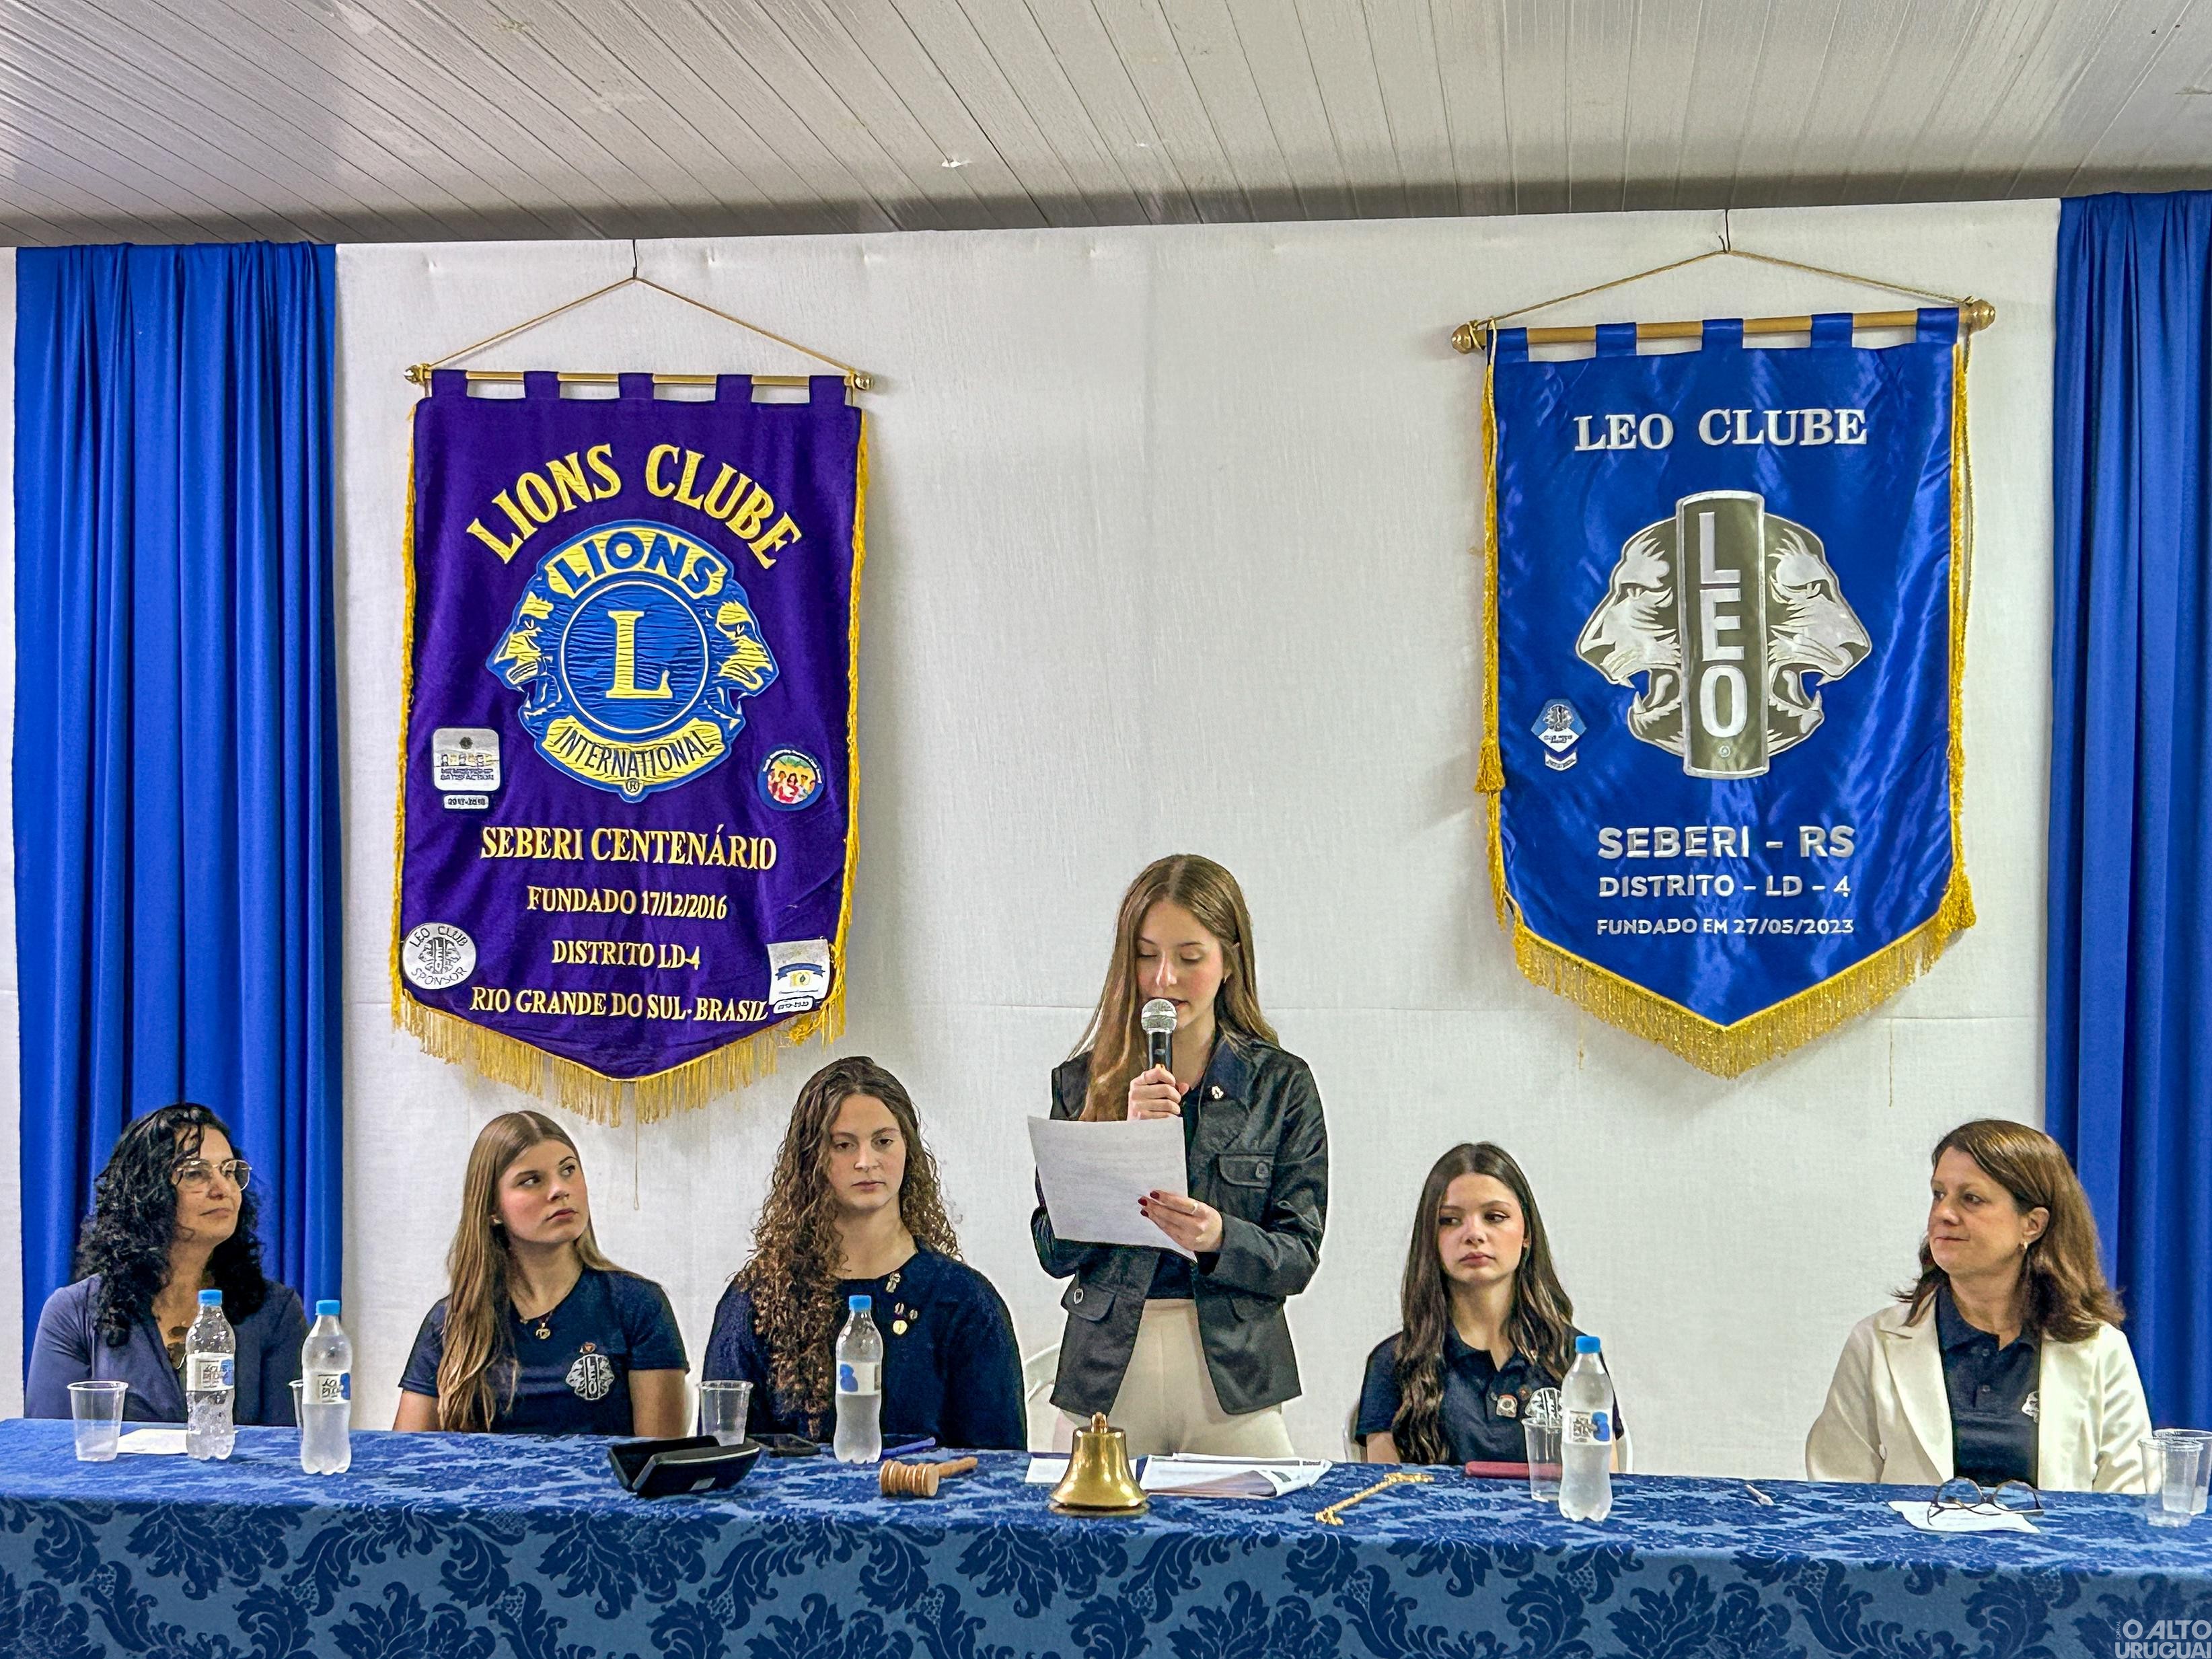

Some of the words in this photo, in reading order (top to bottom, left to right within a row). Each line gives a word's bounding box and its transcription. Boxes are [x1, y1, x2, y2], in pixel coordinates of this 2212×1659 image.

[1574, 413, 1674, 451] LEO
[1699, 408, 1868, 446] CLUBE
[466, 443, 622, 564] LIONS
[645, 443, 802, 569] CLUBE
[554, 531, 721, 595] LIONS
[1698, 511, 1748, 739] LEO
[605, 610, 673, 699] L
[553, 726, 715, 778] INTERNATIONAL
[480, 826, 584, 860] SEBERI
[591, 823, 777, 871] CENTENÁRIO
[1598, 825, 1749, 859] SEBERI
[1799, 825, 1855, 858] RS
[527, 885, 636, 914] FUNDADO
[641, 890, 727, 920] 17/12/2016
[1598, 874, 1735, 897] DISTRITO
[1766, 875, 1802, 897] LD
[1833, 875, 1851, 898] 4
[409, 928, 431, 948] LEO
[1597, 918, 1697, 935] FUNDADO
[1703, 918, 1728, 934] EM
[1733, 918, 1855, 935] 27/05/2023
[434, 939, 443, 972] LEO
[552, 940, 655, 967] DISTRITO
[657, 943, 700, 971] LD-4
[411, 967, 468, 986] SPONSOR
[470, 986, 511, 1013] RIO
[515, 989, 607, 1016] GRANDE
[608, 992, 642, 1018] DO
[586, 1357, 597, 1395] LEO
